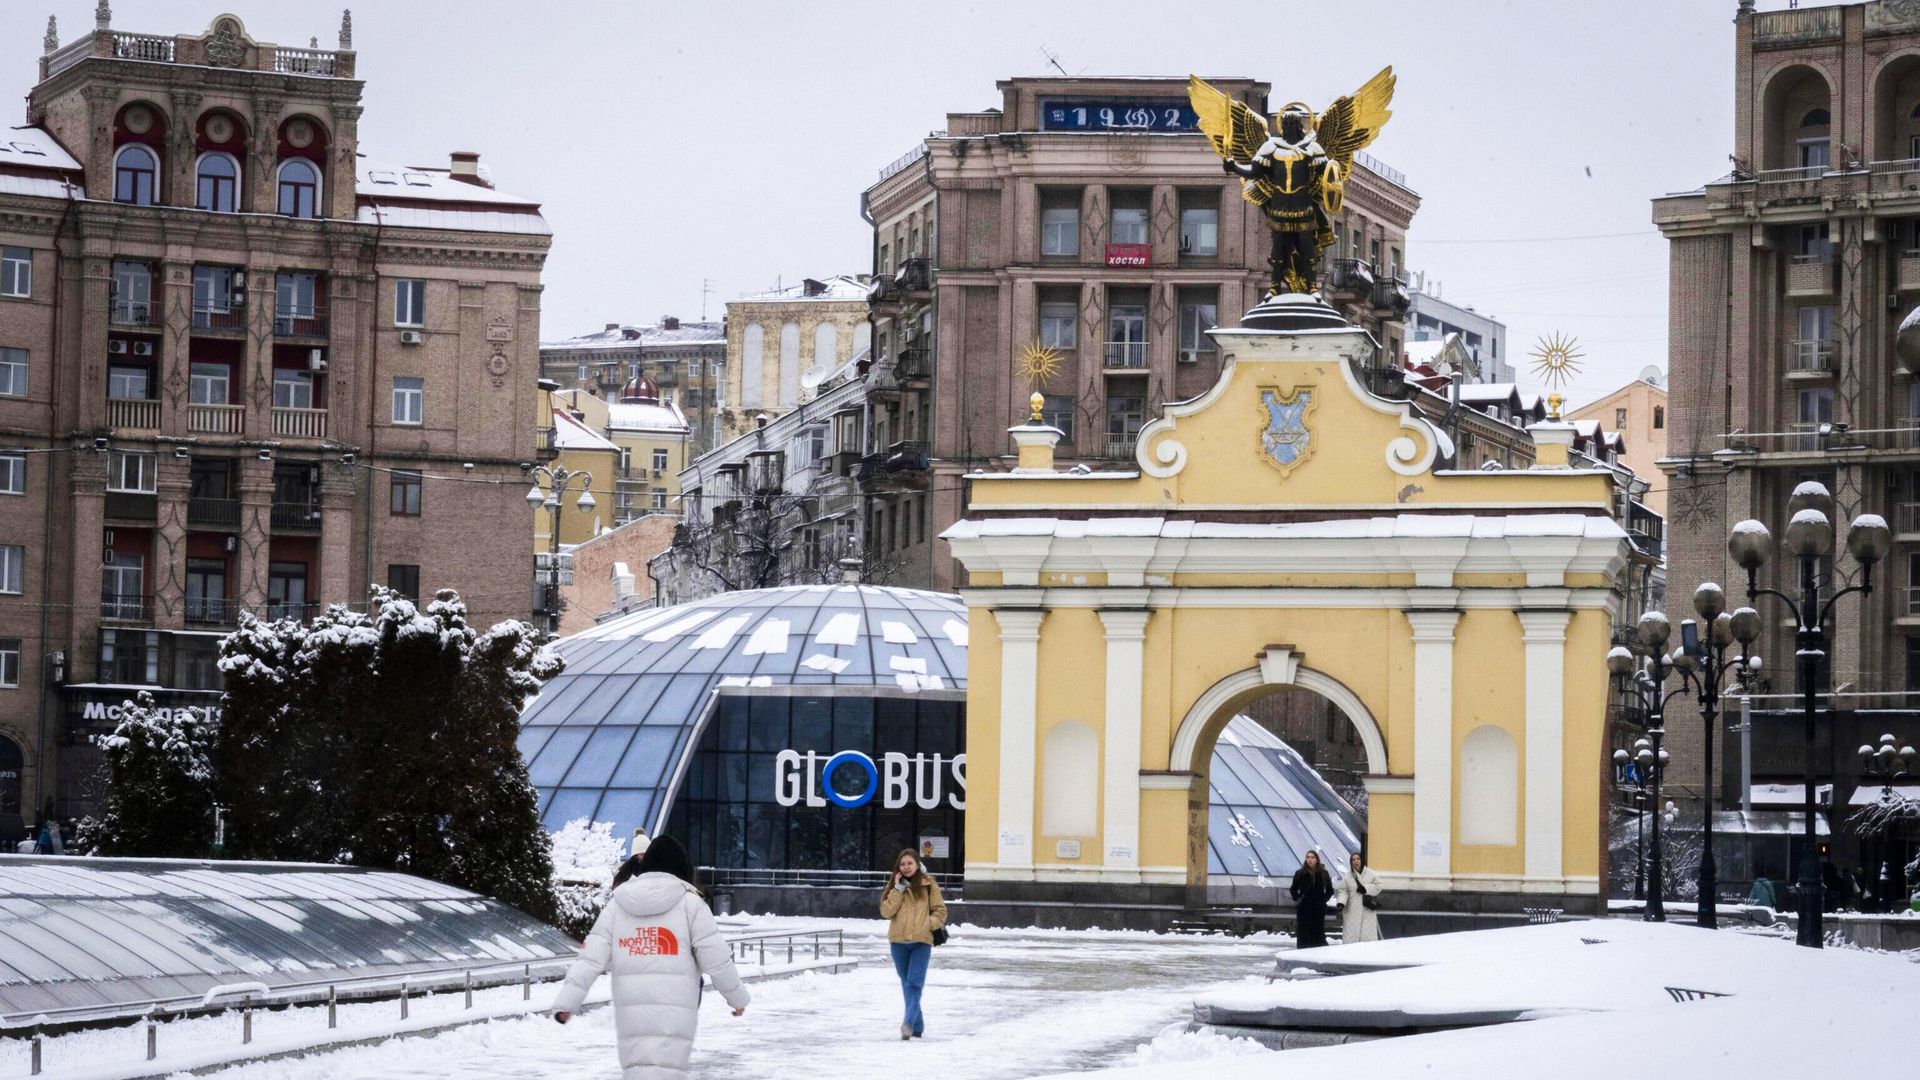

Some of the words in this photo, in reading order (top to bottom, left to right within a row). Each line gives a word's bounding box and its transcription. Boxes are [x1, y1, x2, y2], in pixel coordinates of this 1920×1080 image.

[1109, 256, 1146, 265] хостел
[775, 749, 966, 809] GLOBUS
[635, 927, 657, 936] THE
[619, 936, 657, 947] NORTH
[629, 946, 657, 956] FACE
